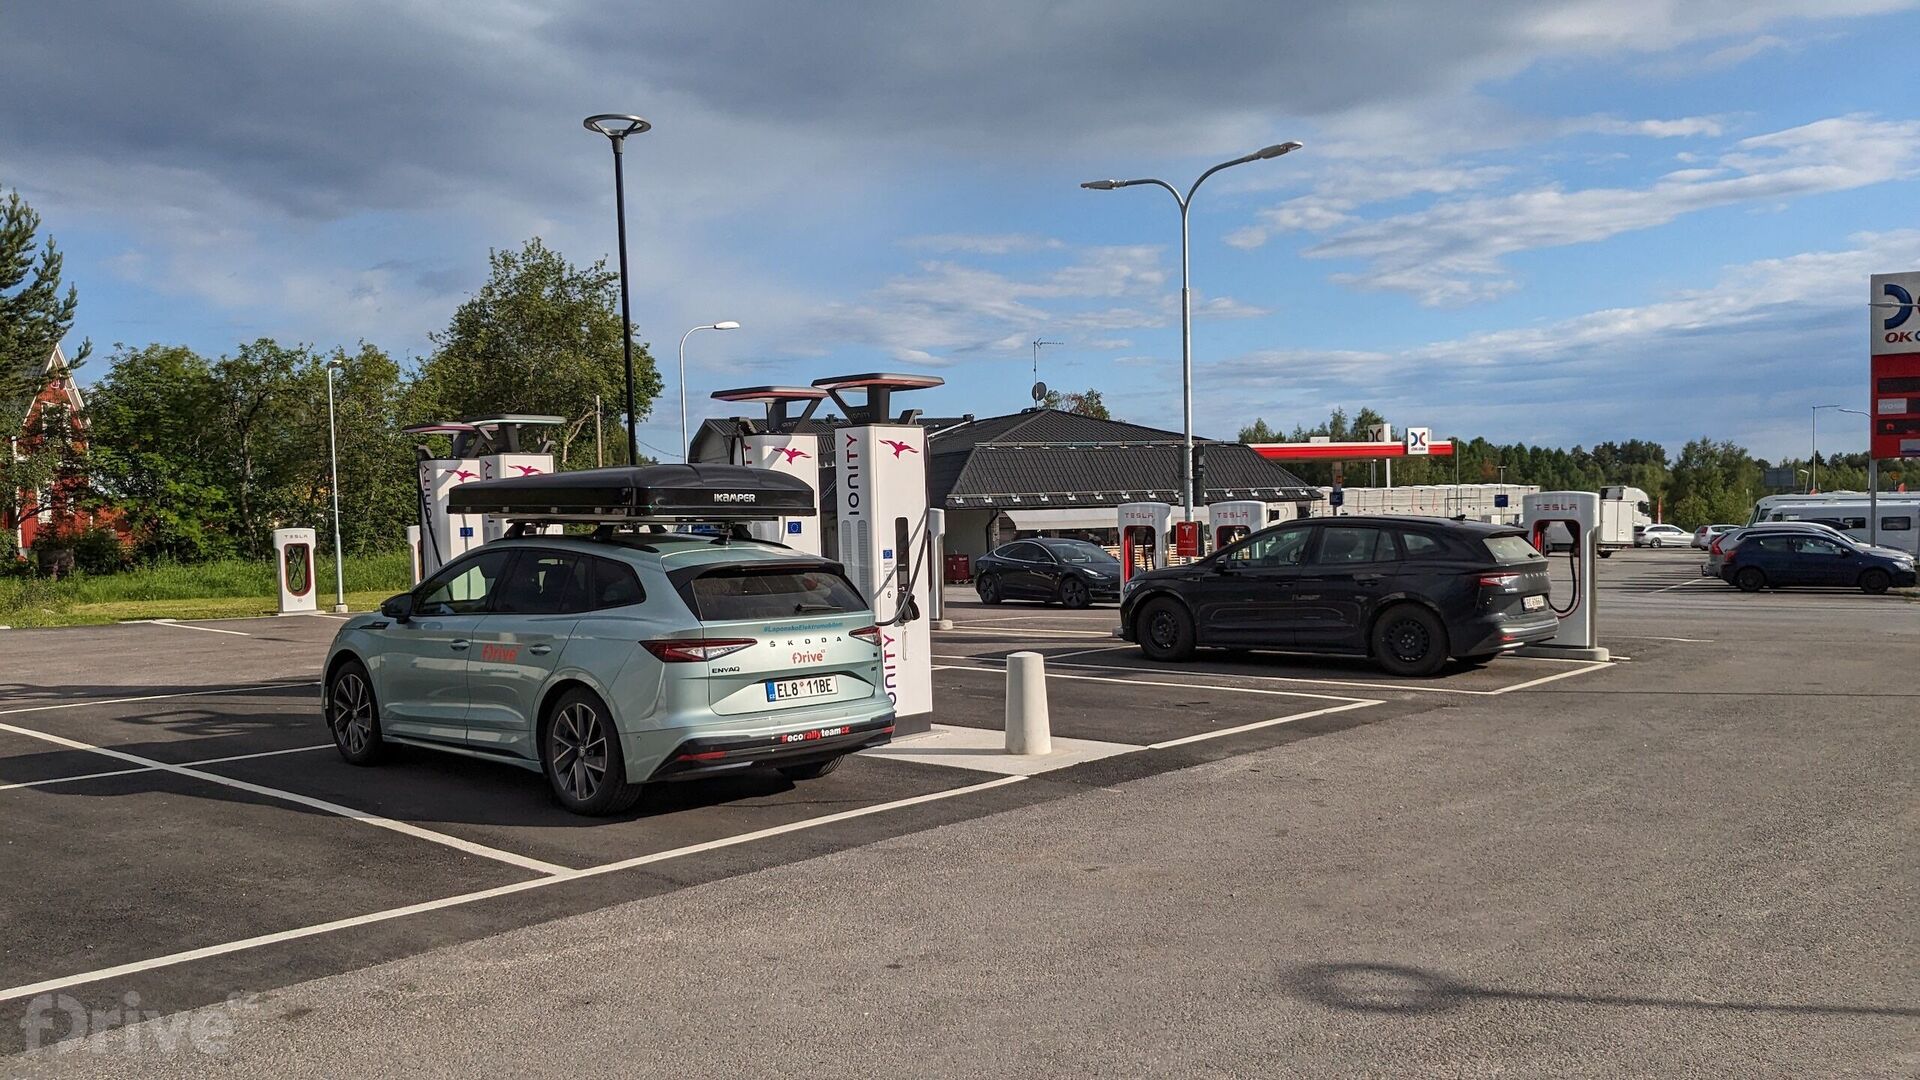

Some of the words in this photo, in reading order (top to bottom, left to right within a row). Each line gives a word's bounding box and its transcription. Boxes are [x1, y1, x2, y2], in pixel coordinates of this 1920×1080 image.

[846, 433, 859, 515] IONITY
[713, 493, 756, 503] IKAMPER
[1536, 503, 1577, 511] TESLA
[887, 590, 892, 599] 6
[712, 666, 740, 674] ENYAQ
[883, 634, 897, 707] ONITY
[777, 681, 799, 698] EL8
[807, 678, 833, 695] 11BE
